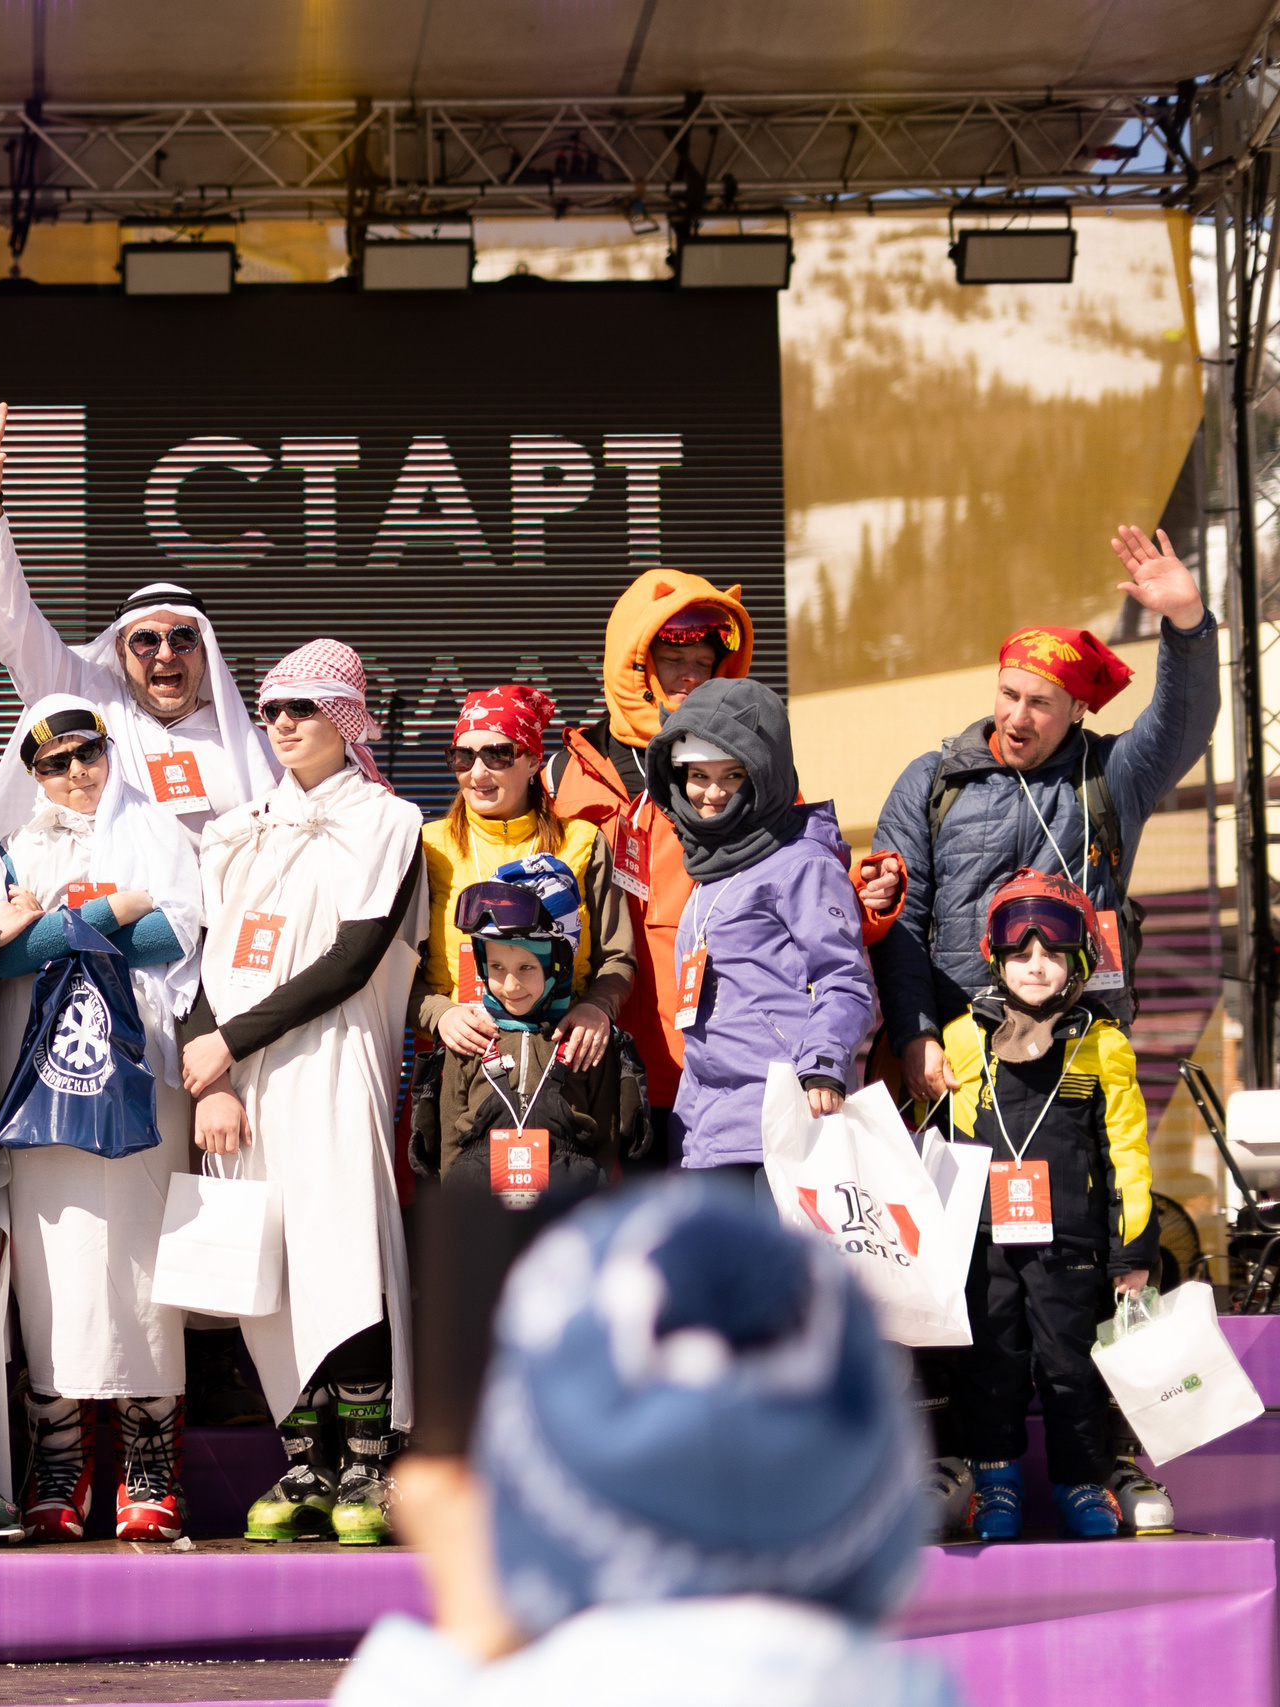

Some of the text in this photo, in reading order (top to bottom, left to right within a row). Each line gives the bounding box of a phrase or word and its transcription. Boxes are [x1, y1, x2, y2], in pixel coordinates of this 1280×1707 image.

[144, 434, 683, 568] СТАРТ
[168, 784, 190, 795] 120
[624, 858, 640, 873] 198
[247, 953, 269, 965] 115
[507, 1173, 532, 1184] 180
[1008, 1206, 1034, 1217] 179
[1160, 1375, 1201, 1402] drivee
[348, 1405, 382, 1418] ATOMIC
